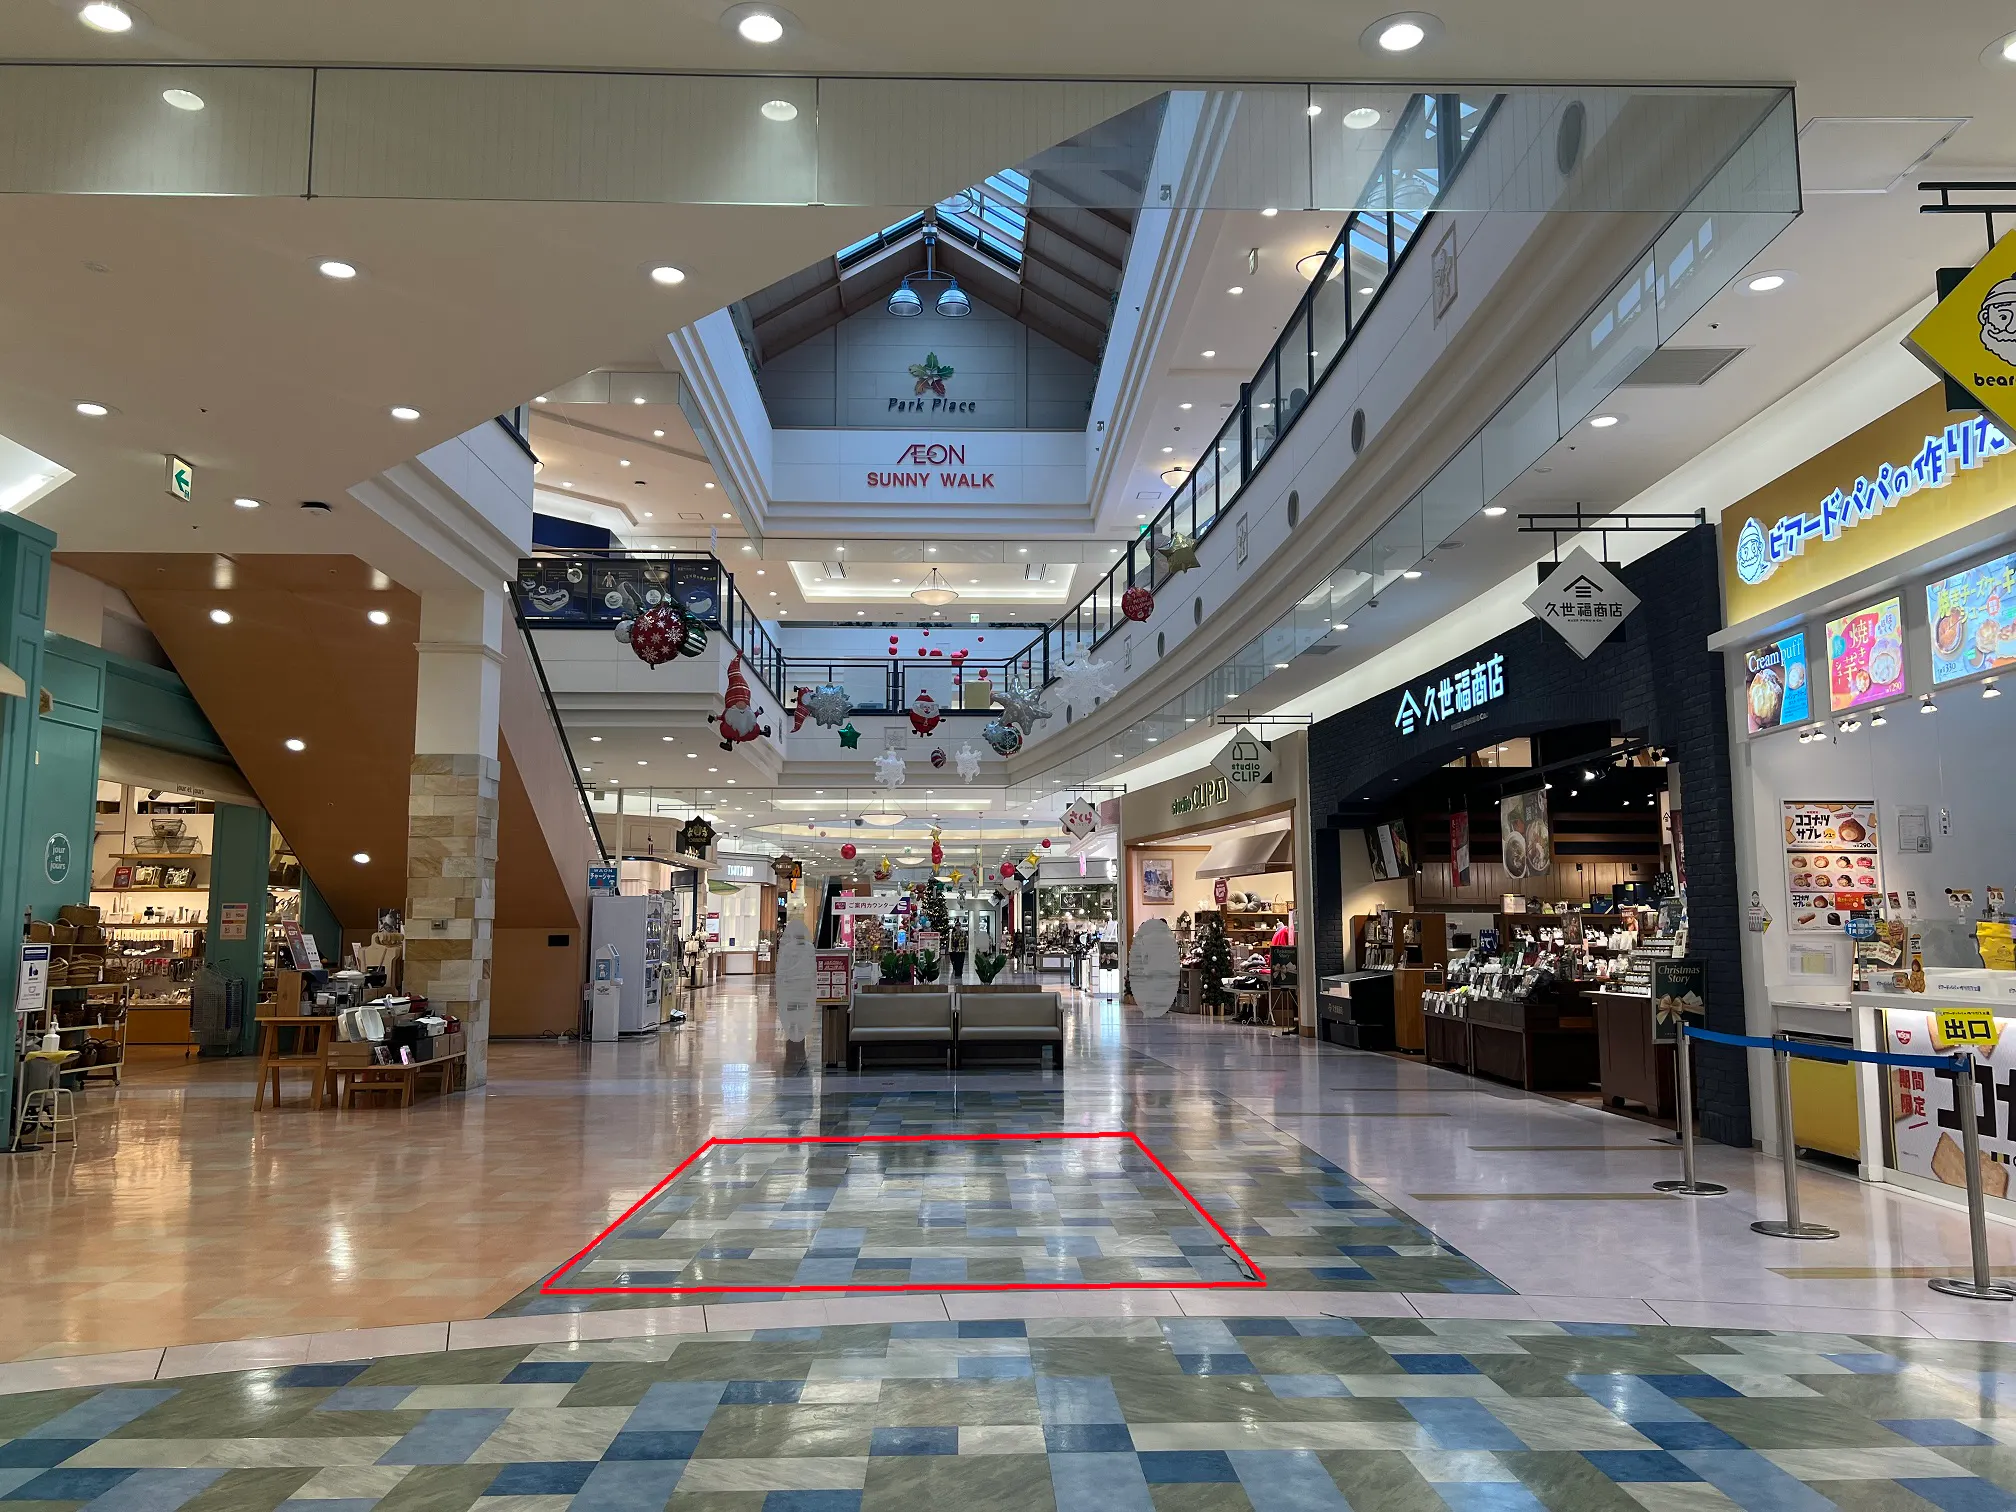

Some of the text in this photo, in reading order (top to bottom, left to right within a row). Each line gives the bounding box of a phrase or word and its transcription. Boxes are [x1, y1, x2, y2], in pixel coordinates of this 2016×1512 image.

[1974, 372, 2016, 386] bear
[888, 398, 976, 413] Park Place
[867, 472, 995, 488] SUNNY WALK
[1544, 602, 1623, 617] 久世福商店
[1748, 638, 1802, 673] Cream puff
[1424, 653, 1504, 726] 久世福商店
[1232, 771, 1260, 782] CLIP
[1795, 814, 1830, 826] ココナッツ
[1796, 826, 1821, 840] サブレ
[52, 844, 66, 854] jour
[50, 861, 66, 871] jours
[1658, 965, 1701, 975] Christmas
[1668, 974, 1691, 985] Story
[1945, 1019, 1992, 1039] 出口
[1899, 1068, 1925, 1091] 期間
[1901, 1093, 1927, 1117] 限定
